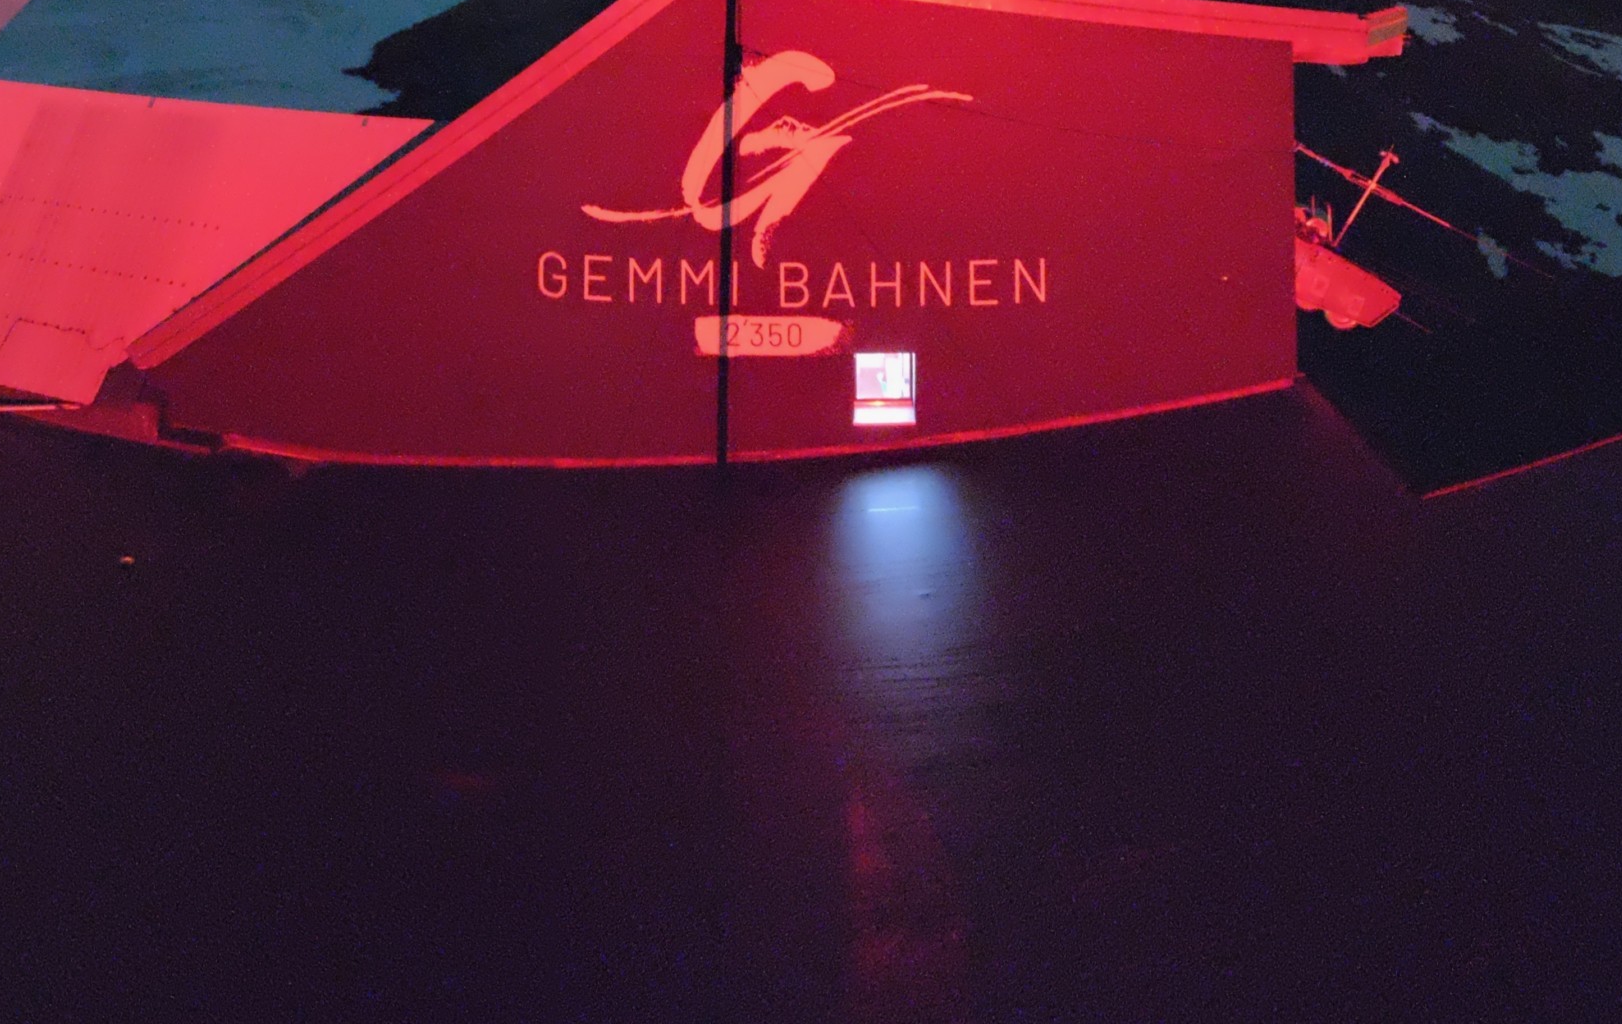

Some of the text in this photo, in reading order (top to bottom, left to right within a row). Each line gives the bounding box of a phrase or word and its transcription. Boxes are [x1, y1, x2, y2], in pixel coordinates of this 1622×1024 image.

[538, 251, 1046, 308] GEMMI BAHNEN
[726, 320, 803, 348] 2'350
